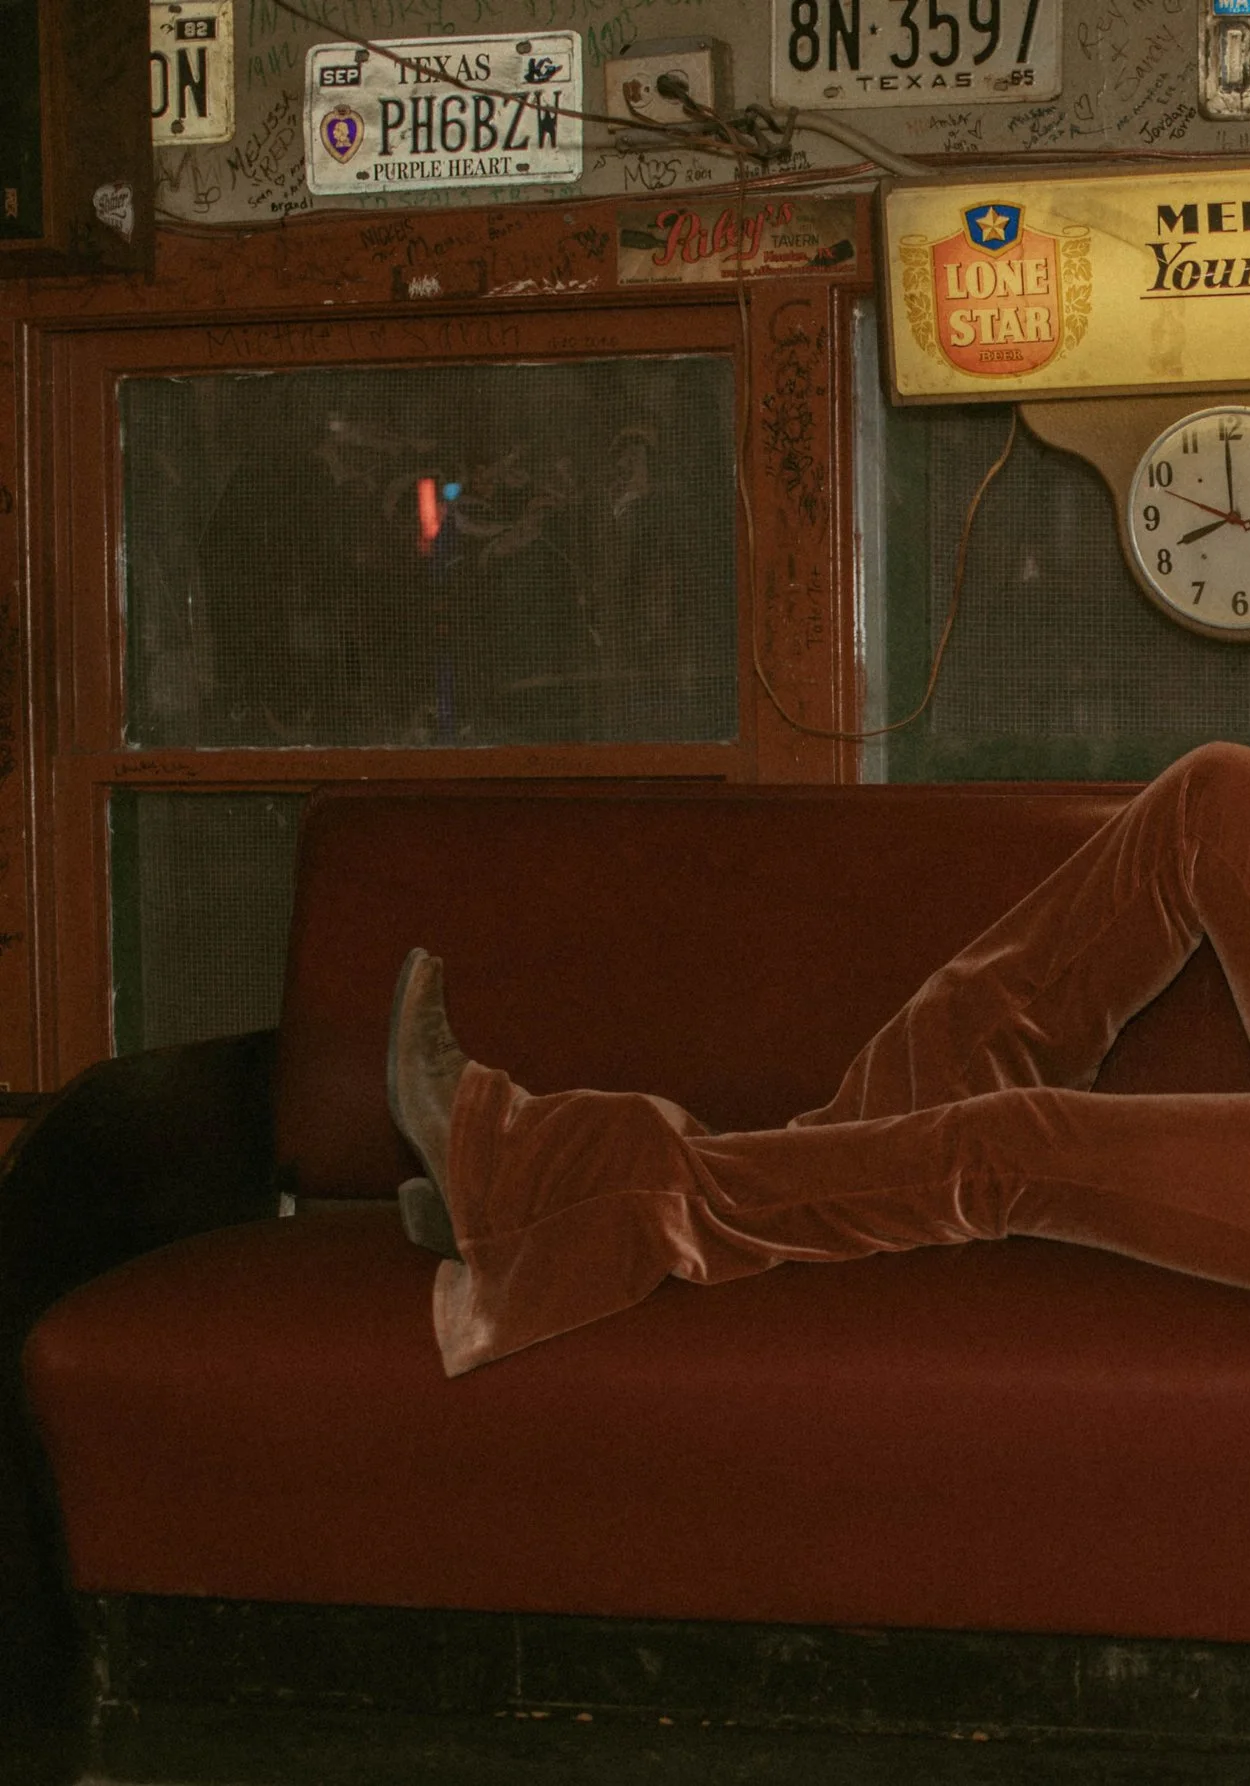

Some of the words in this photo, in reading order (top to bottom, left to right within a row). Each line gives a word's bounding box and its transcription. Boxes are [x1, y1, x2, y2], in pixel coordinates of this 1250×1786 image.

[184, 22, 208, 37] 82
[789, 0, 860, 71] 8N
[889, 0, 1041, 69] 3597
[322, 68, 360, 86] SEP
[394, 53, 491, 86] TEXAS
[856, 71, 973, 91] TEXAS
[377, 91, 562, 157] PH6BZW
[373, 159, 443, 181] PURPLE
[447, 156, 513, 177] HEART
[771, 233, 820, 249] TAVERN
[943, 257, 1051, 301] LONE
[950, 305, 1055, 347] STAR
[979, 350, 1024, 362] BEER
[1218, 415, 1244, 442] 12
[1181, 430, 1199, 455] 11
[1148, 460, 1173, 488] 10
[1143, 505, 1161, 532] 9
[1157, 548, 1173, 576] 8
[1191, 580, 1206, 606] 7
[1231, 590, 1250, 616] 6
